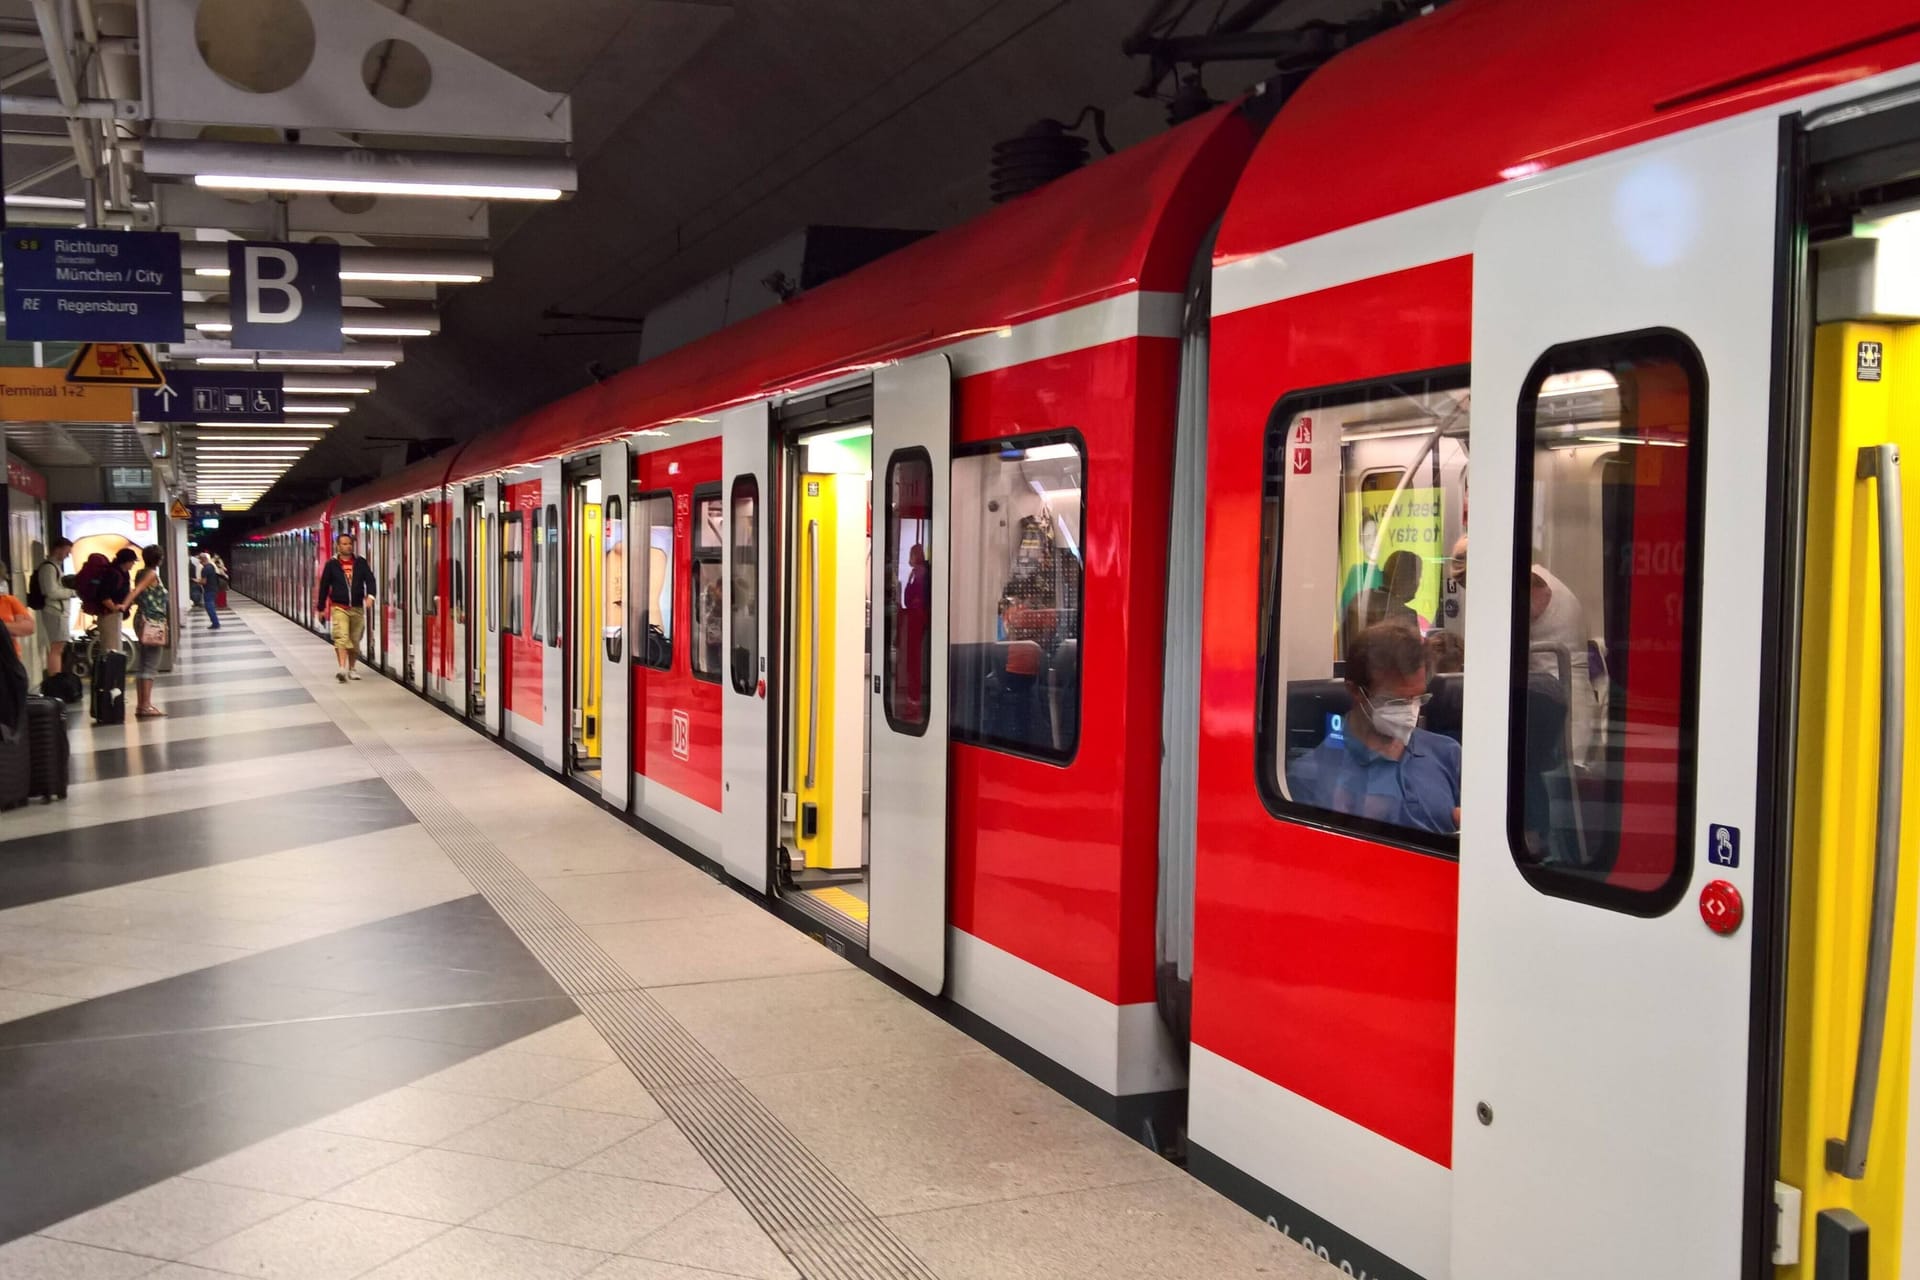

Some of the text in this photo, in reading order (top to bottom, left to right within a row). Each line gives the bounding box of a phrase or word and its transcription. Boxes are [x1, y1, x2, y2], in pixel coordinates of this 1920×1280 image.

[54, 239, 118, 256] Richtung
[56, 267, 122, 282] München
[135, 269, 164, 285] City
[244, 246, 304, 324] B
[22, 297, 41, 311] RE
[57, 298, 138, 315] Regensburg
[0, 384, 86, 397] Terminal 1+2
[674, 718, 687, 750] DB
